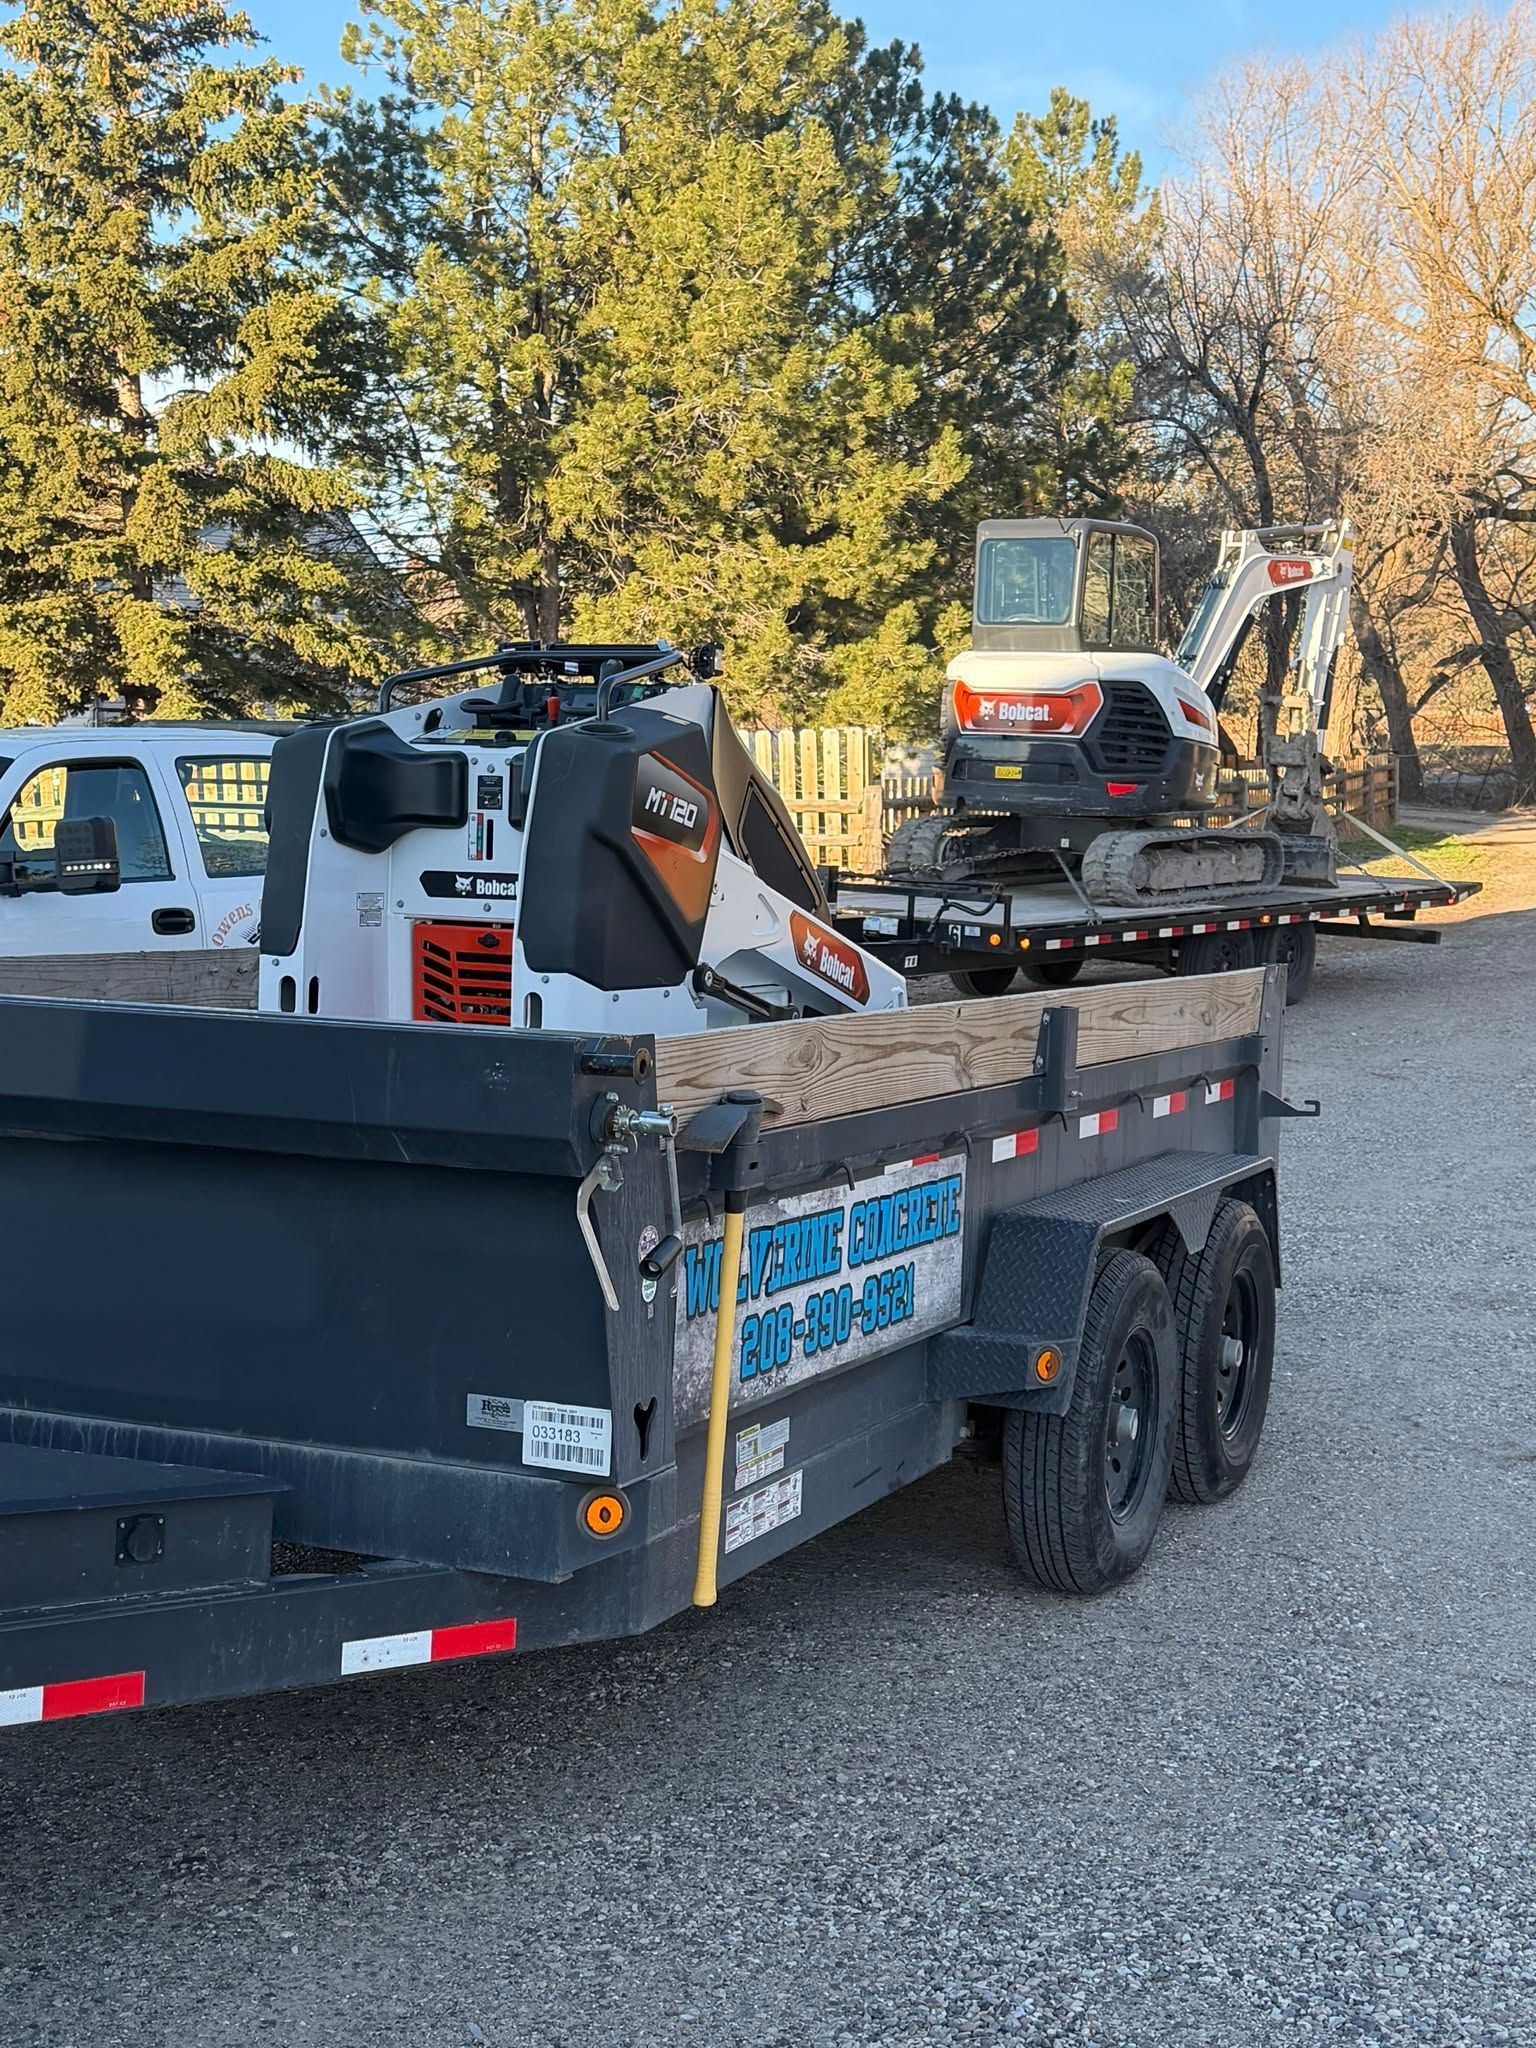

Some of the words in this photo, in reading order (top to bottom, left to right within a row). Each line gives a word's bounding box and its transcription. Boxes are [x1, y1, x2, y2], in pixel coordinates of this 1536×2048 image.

[998, 701, 1050, 721] Bobcat
[820, 946, 855, 991] Bobcat
[848, 1173, 963, 1269] CONCRETE
[740, 1261, 916, 1383] 208-390-9521
[532, 1425, 580, 1443] 033183
